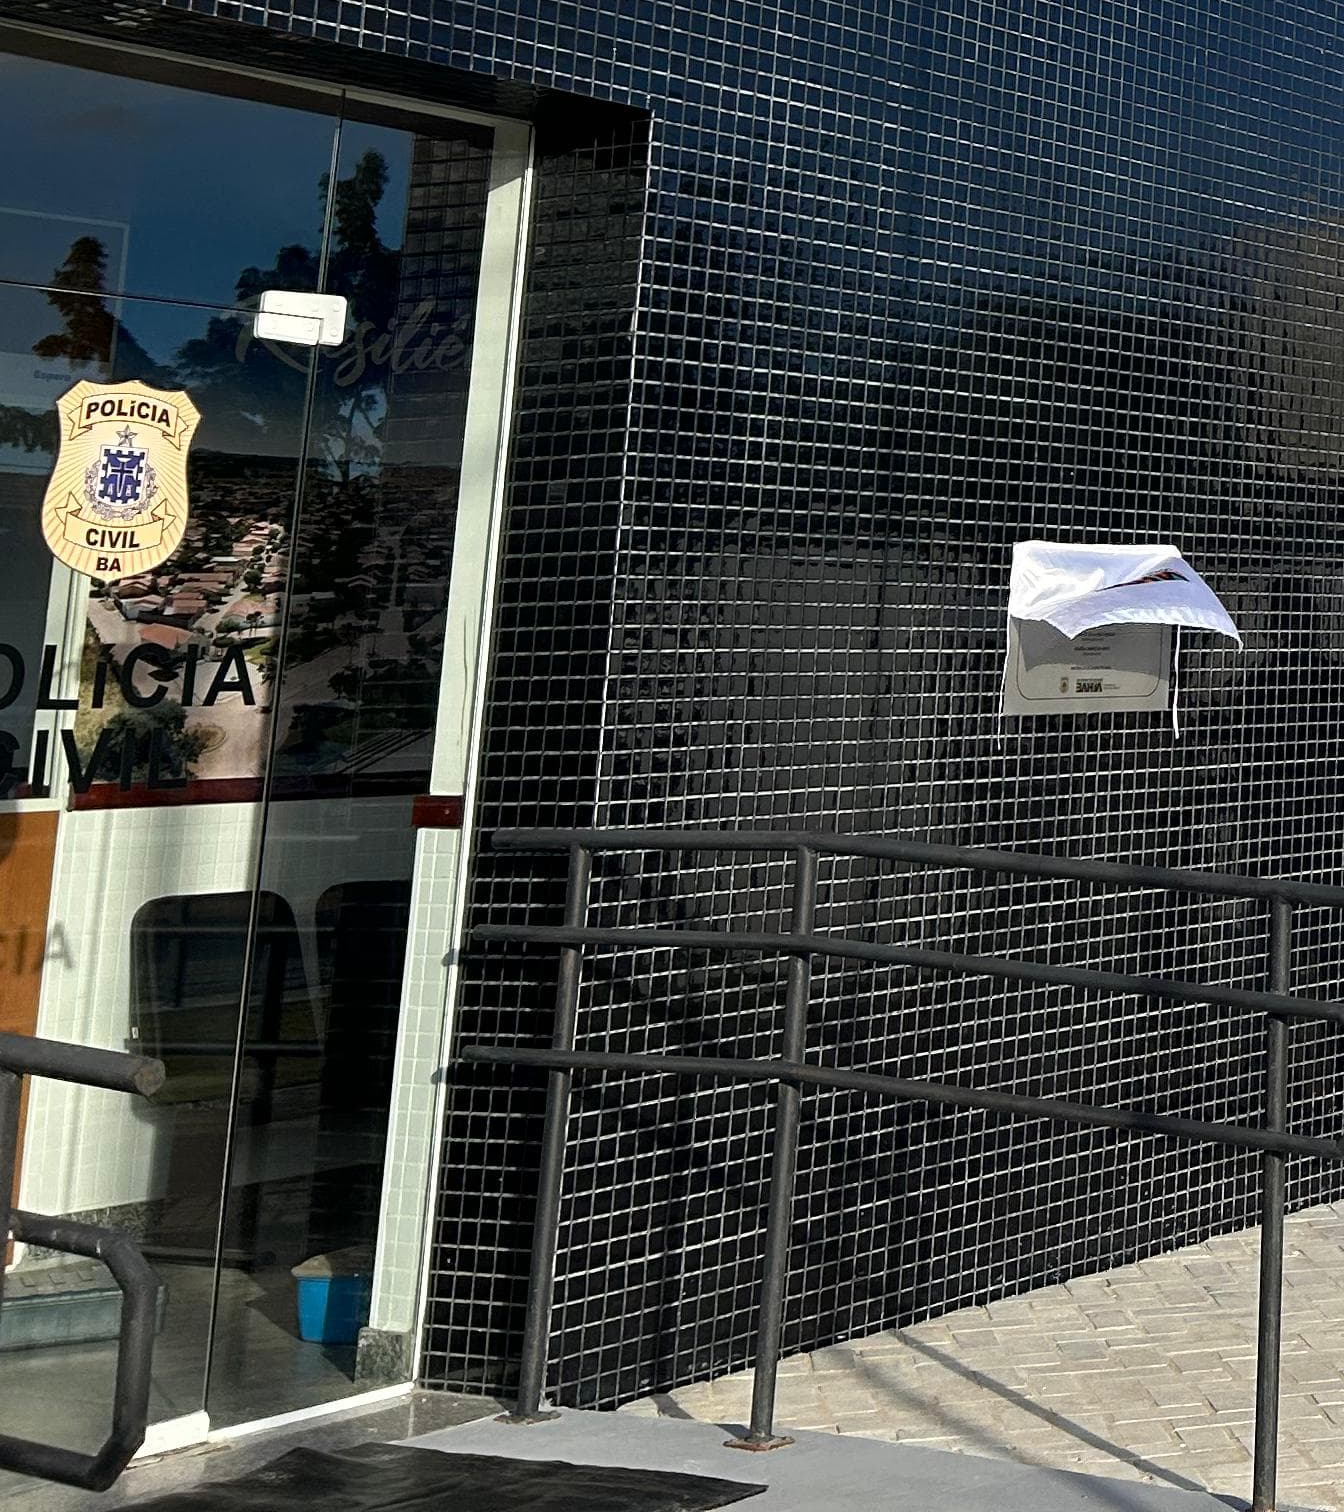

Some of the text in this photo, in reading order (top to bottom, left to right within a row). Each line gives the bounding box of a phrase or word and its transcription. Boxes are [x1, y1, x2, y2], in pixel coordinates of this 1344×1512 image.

[86, 399, 171, 428] POLÍCIA
[84, 525, 141, 550] CIVIL
[96, 555, 122, 574] BA
[0, 643, 257, 711] OLÍCIA
